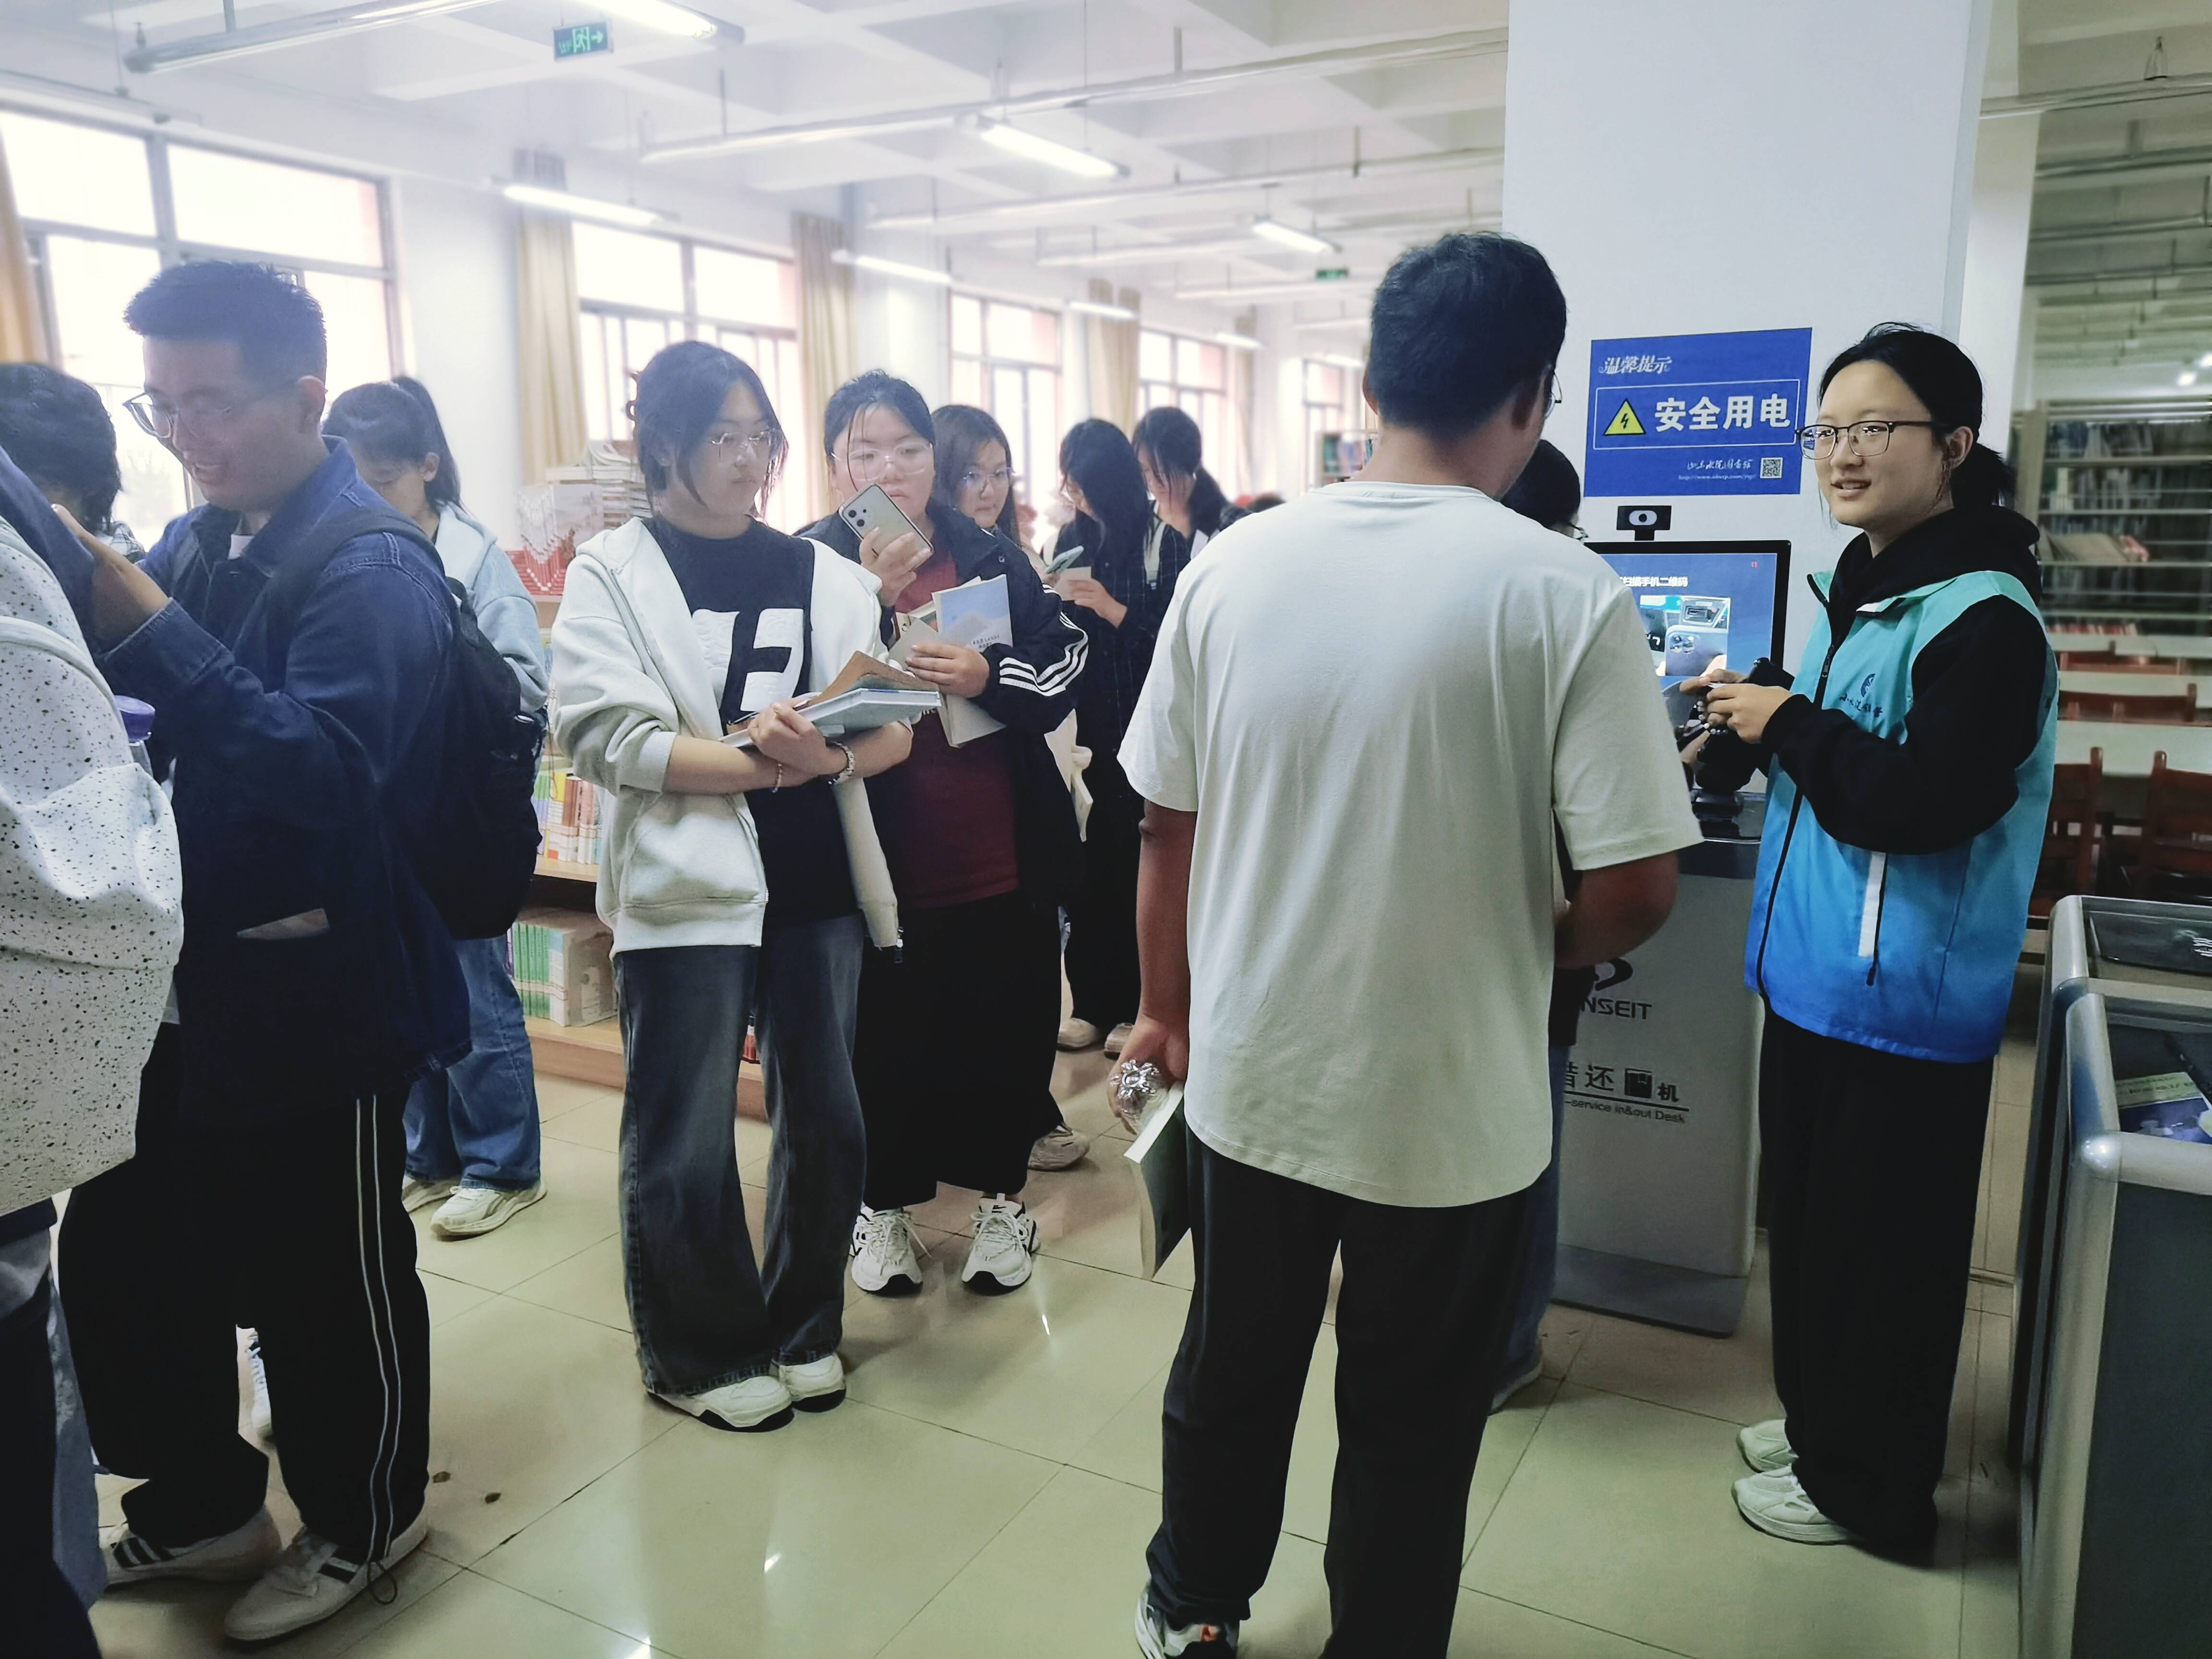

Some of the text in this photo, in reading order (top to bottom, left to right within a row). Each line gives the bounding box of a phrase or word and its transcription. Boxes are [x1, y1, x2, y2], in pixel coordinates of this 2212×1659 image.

[1598, 355, 1672, 374] 温馨提示
[1654, 393, 1791, 432] 安全用电
